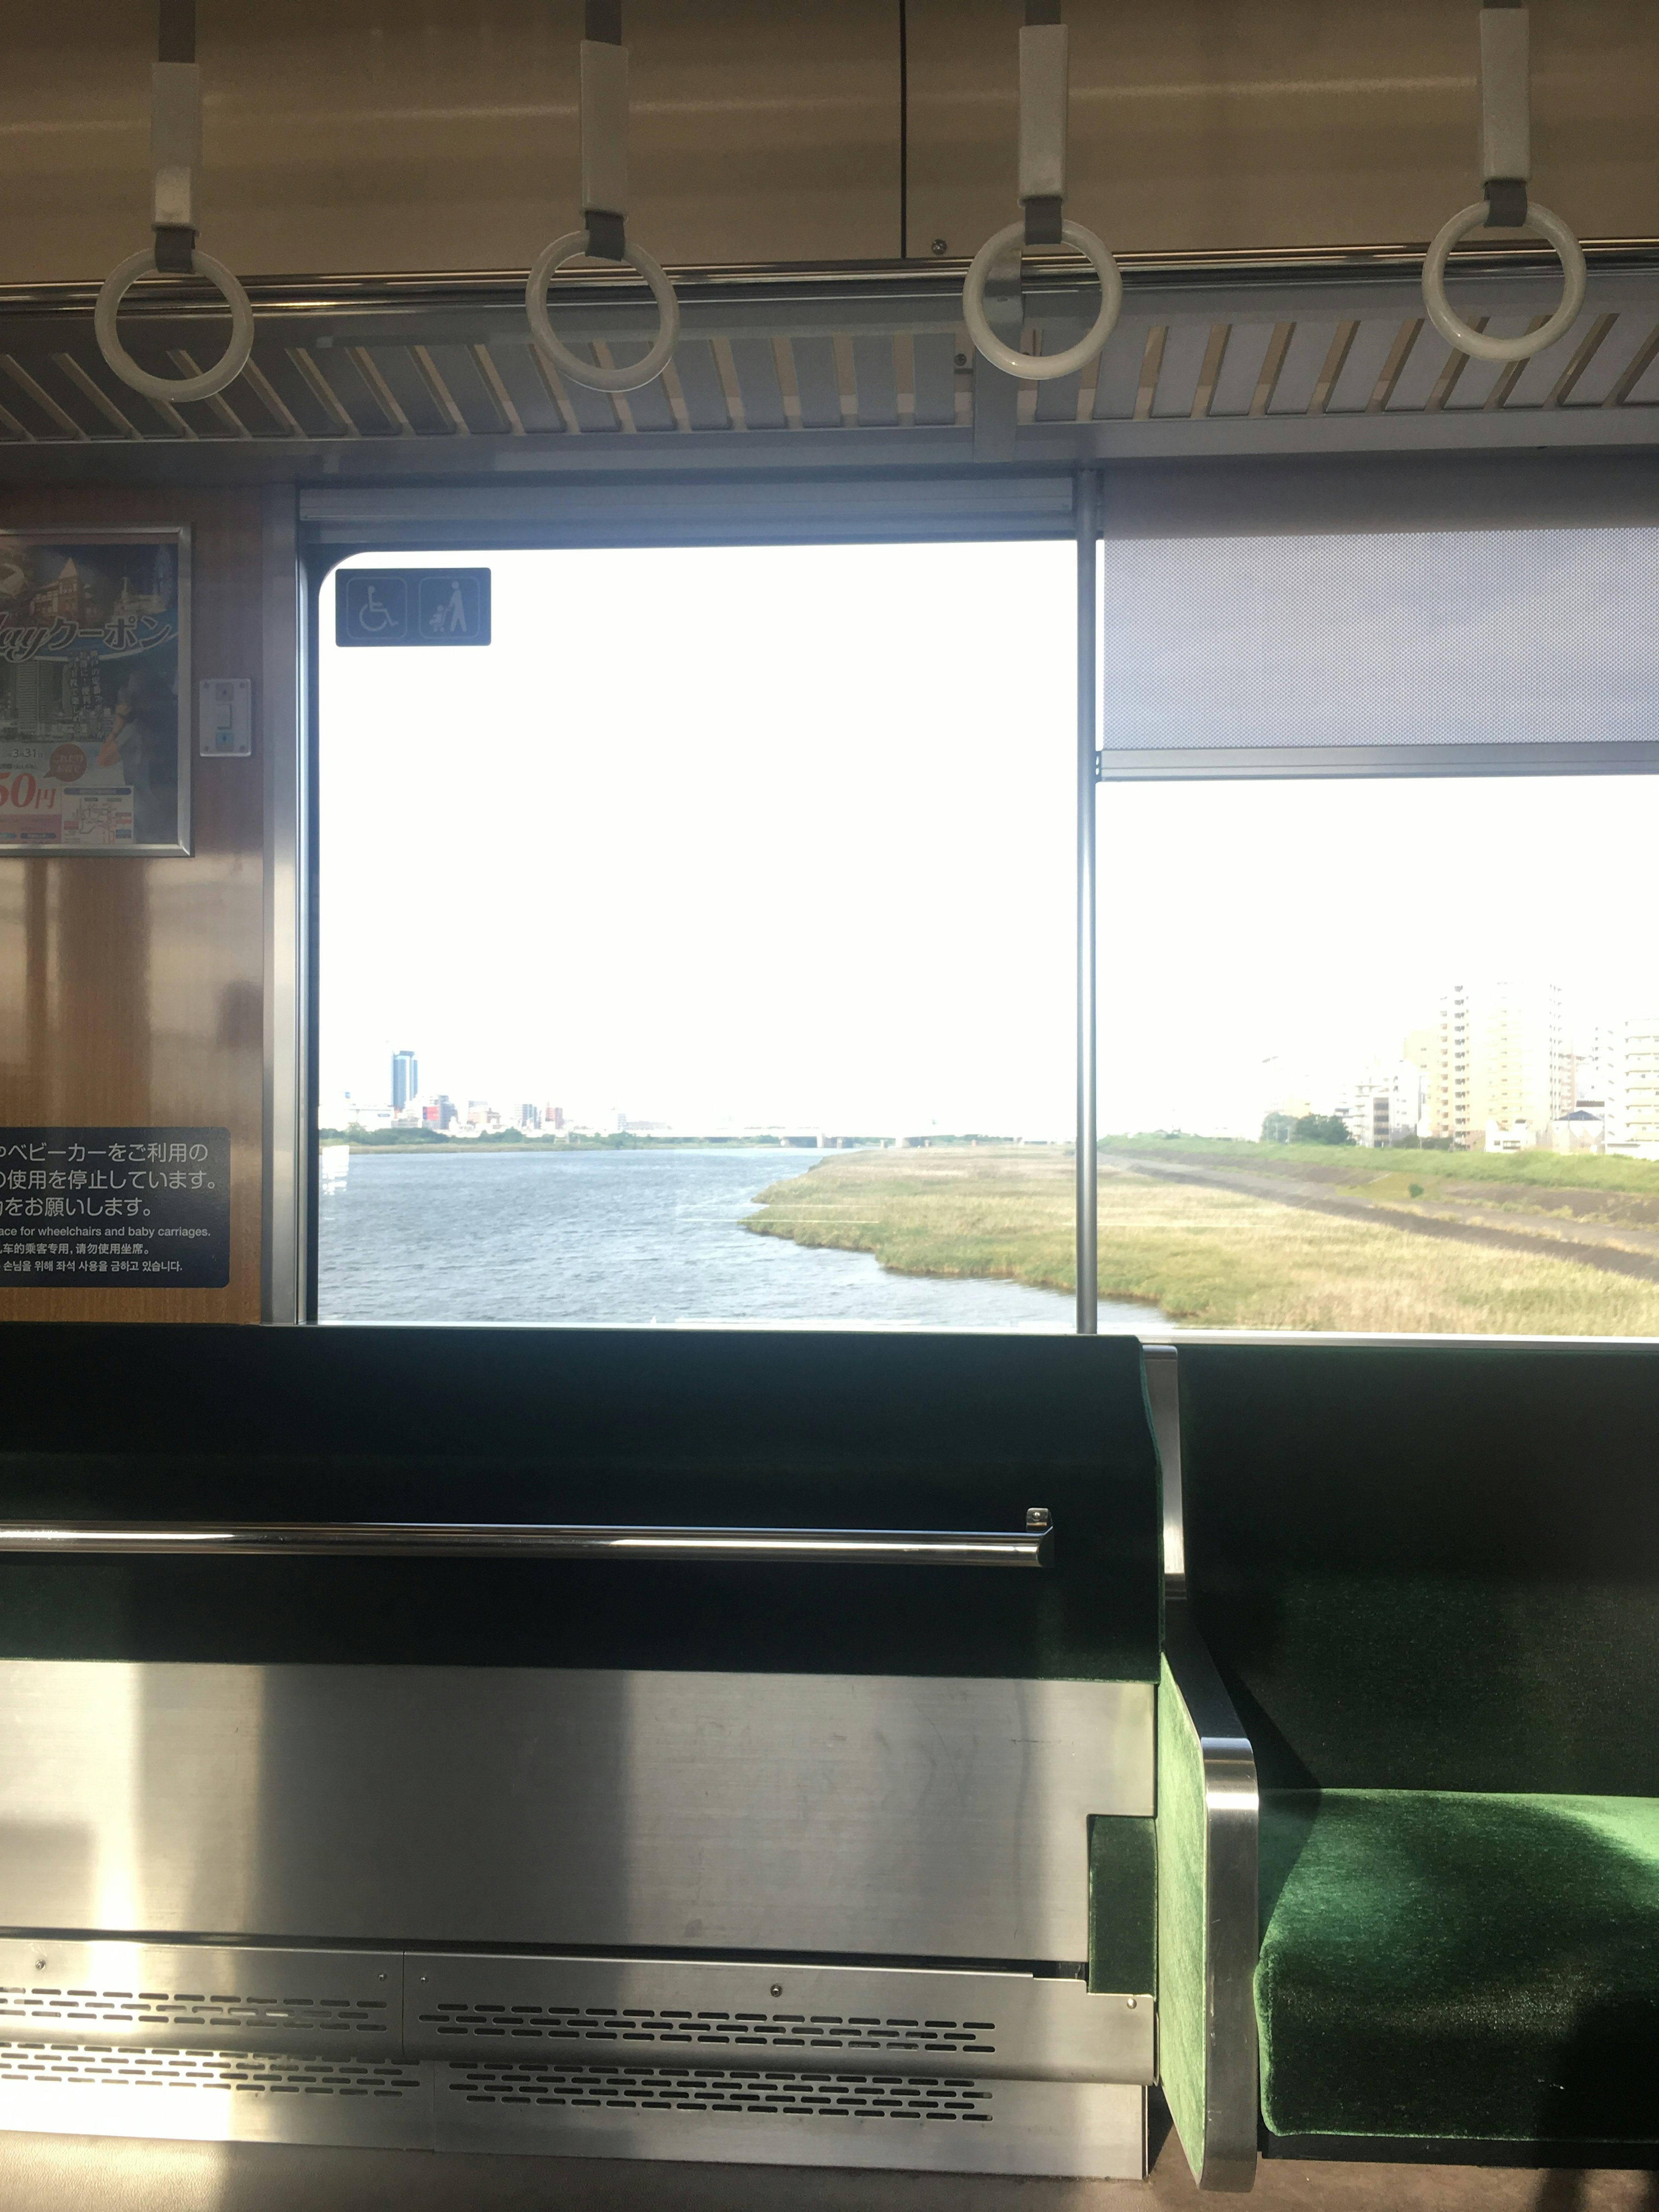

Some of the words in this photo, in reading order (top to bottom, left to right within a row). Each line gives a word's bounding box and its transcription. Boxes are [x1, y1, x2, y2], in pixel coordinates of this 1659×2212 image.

[0, 1197, 151, 1217] をお願いします。
[19, 1226, 35, 1236] for
[38, 1226, 102, 1236] wheelchairs
[104, 1226, 125, 1236] and
[128, 1226, 155, 1239] baby
[158, 1226, 211, 1239] carriages.
[0, 1243, 149, 1255] 车的乘客专用，请勿使用坐席。
[3, 1260, 32, 1271] 손님을
[34, 1260, 53, 1271] 위해
[56, 1260, 75, 1271] 좌석
[78, 1260, 108, 1272] 사용을
[110, 1260, 139, 1272] 금하고
[142, 1260, 183, 1272] 있습니다.
